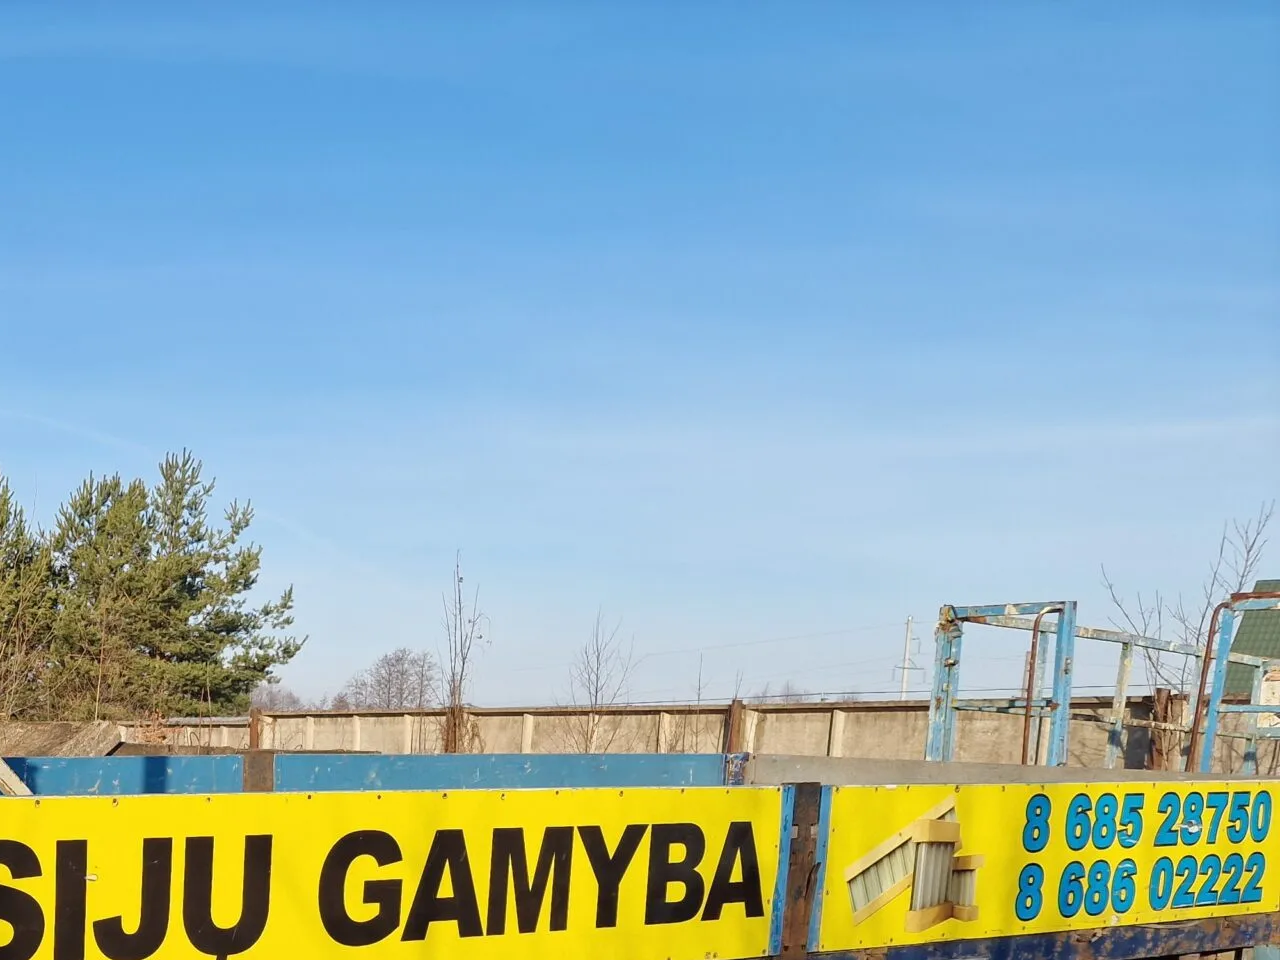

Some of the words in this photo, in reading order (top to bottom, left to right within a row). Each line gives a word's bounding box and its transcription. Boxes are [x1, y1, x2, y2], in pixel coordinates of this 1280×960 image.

[1022, 793, 1051, 853] 8
[1065, 792, 1145, 851] 685
[1153, 790, 1272, 848] 28750
[319, 821, 765, 947] GAMYBA
[1015, 863, 1045, 921] 8
[1058, 858, 1138, 918] 686
[1149, 851, 1266, 911] 02222
